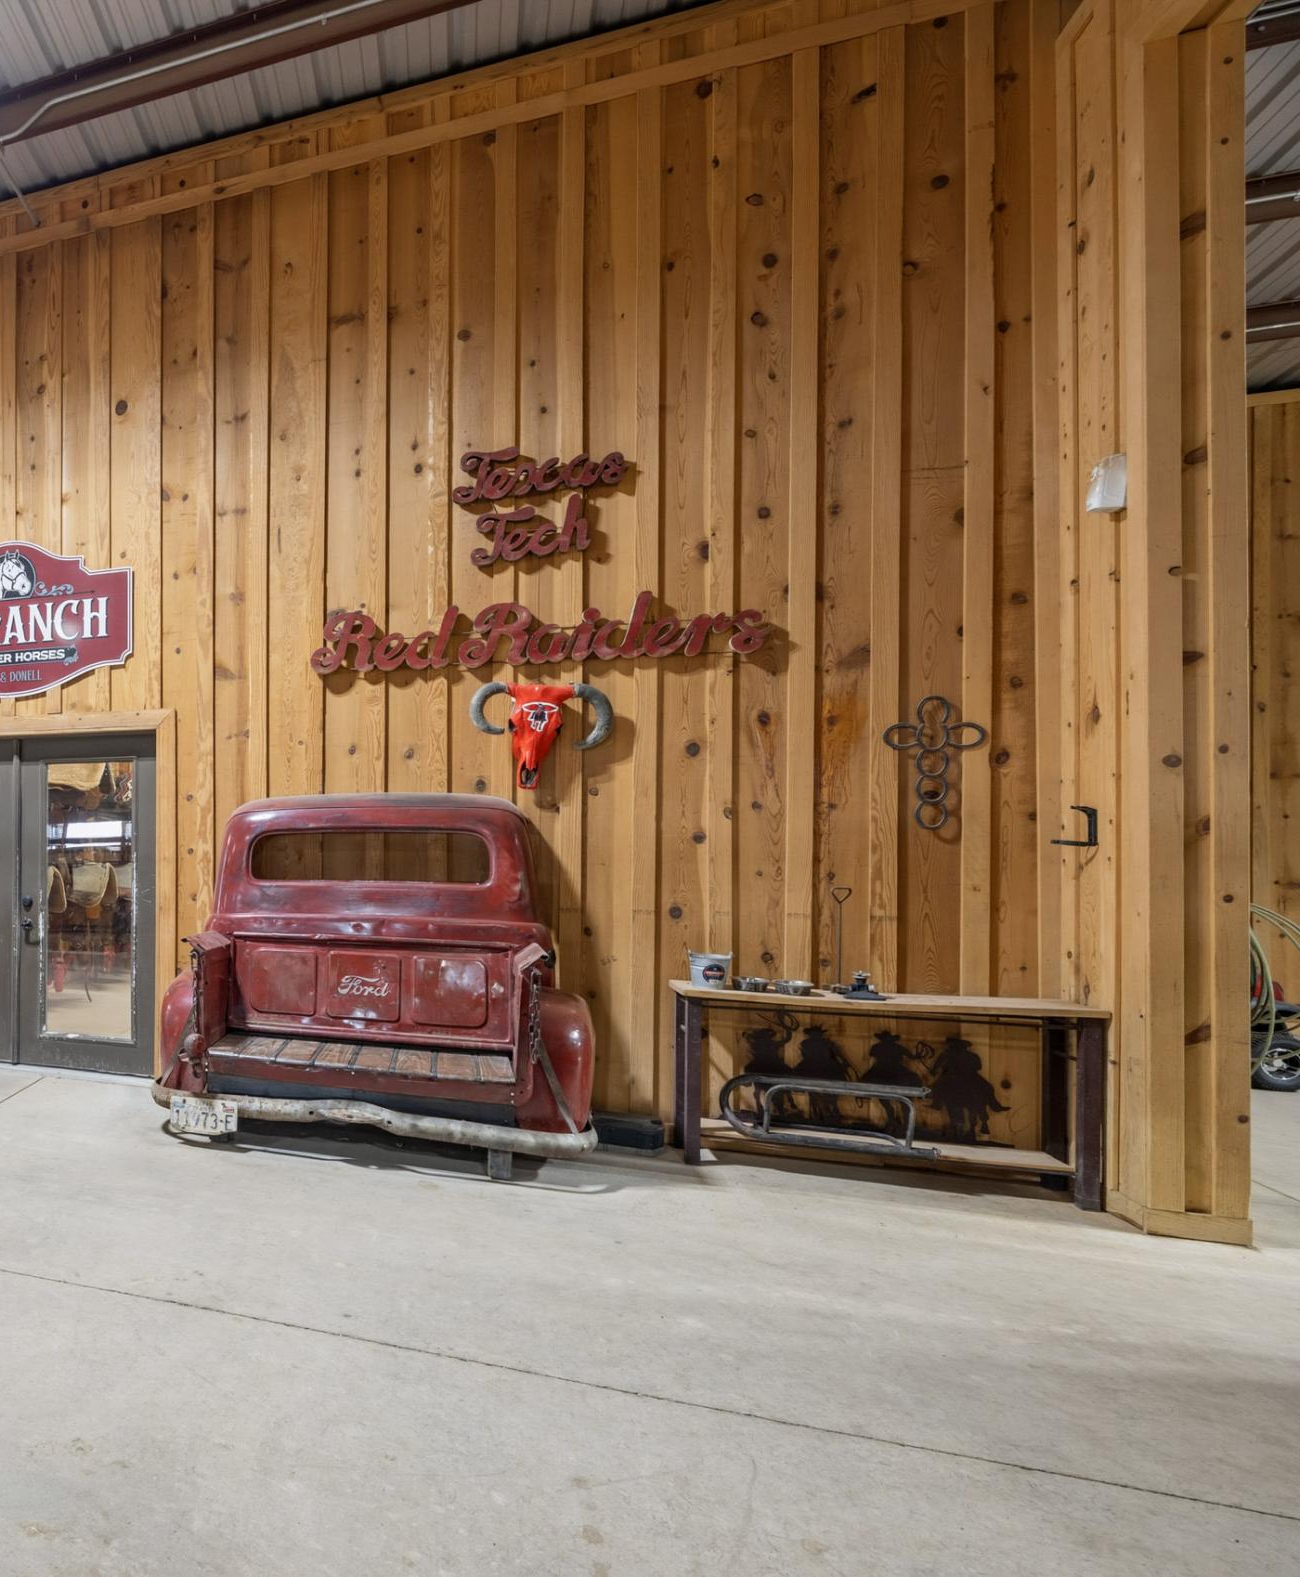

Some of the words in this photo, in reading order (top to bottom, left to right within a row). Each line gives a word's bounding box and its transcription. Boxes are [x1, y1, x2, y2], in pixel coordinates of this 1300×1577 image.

[453, 446, 628, 505] Texas
[470, 493, 591, 567] Tech
[311, 605, 460, 674] Red
[457, 590, 773, 666] Raiders
[15, 649, 65, 663] HORSES
[0, 673, 7, 683] &
[9, 670, 43, 682] DONELL
[337, 975, 390, 997] Ford
